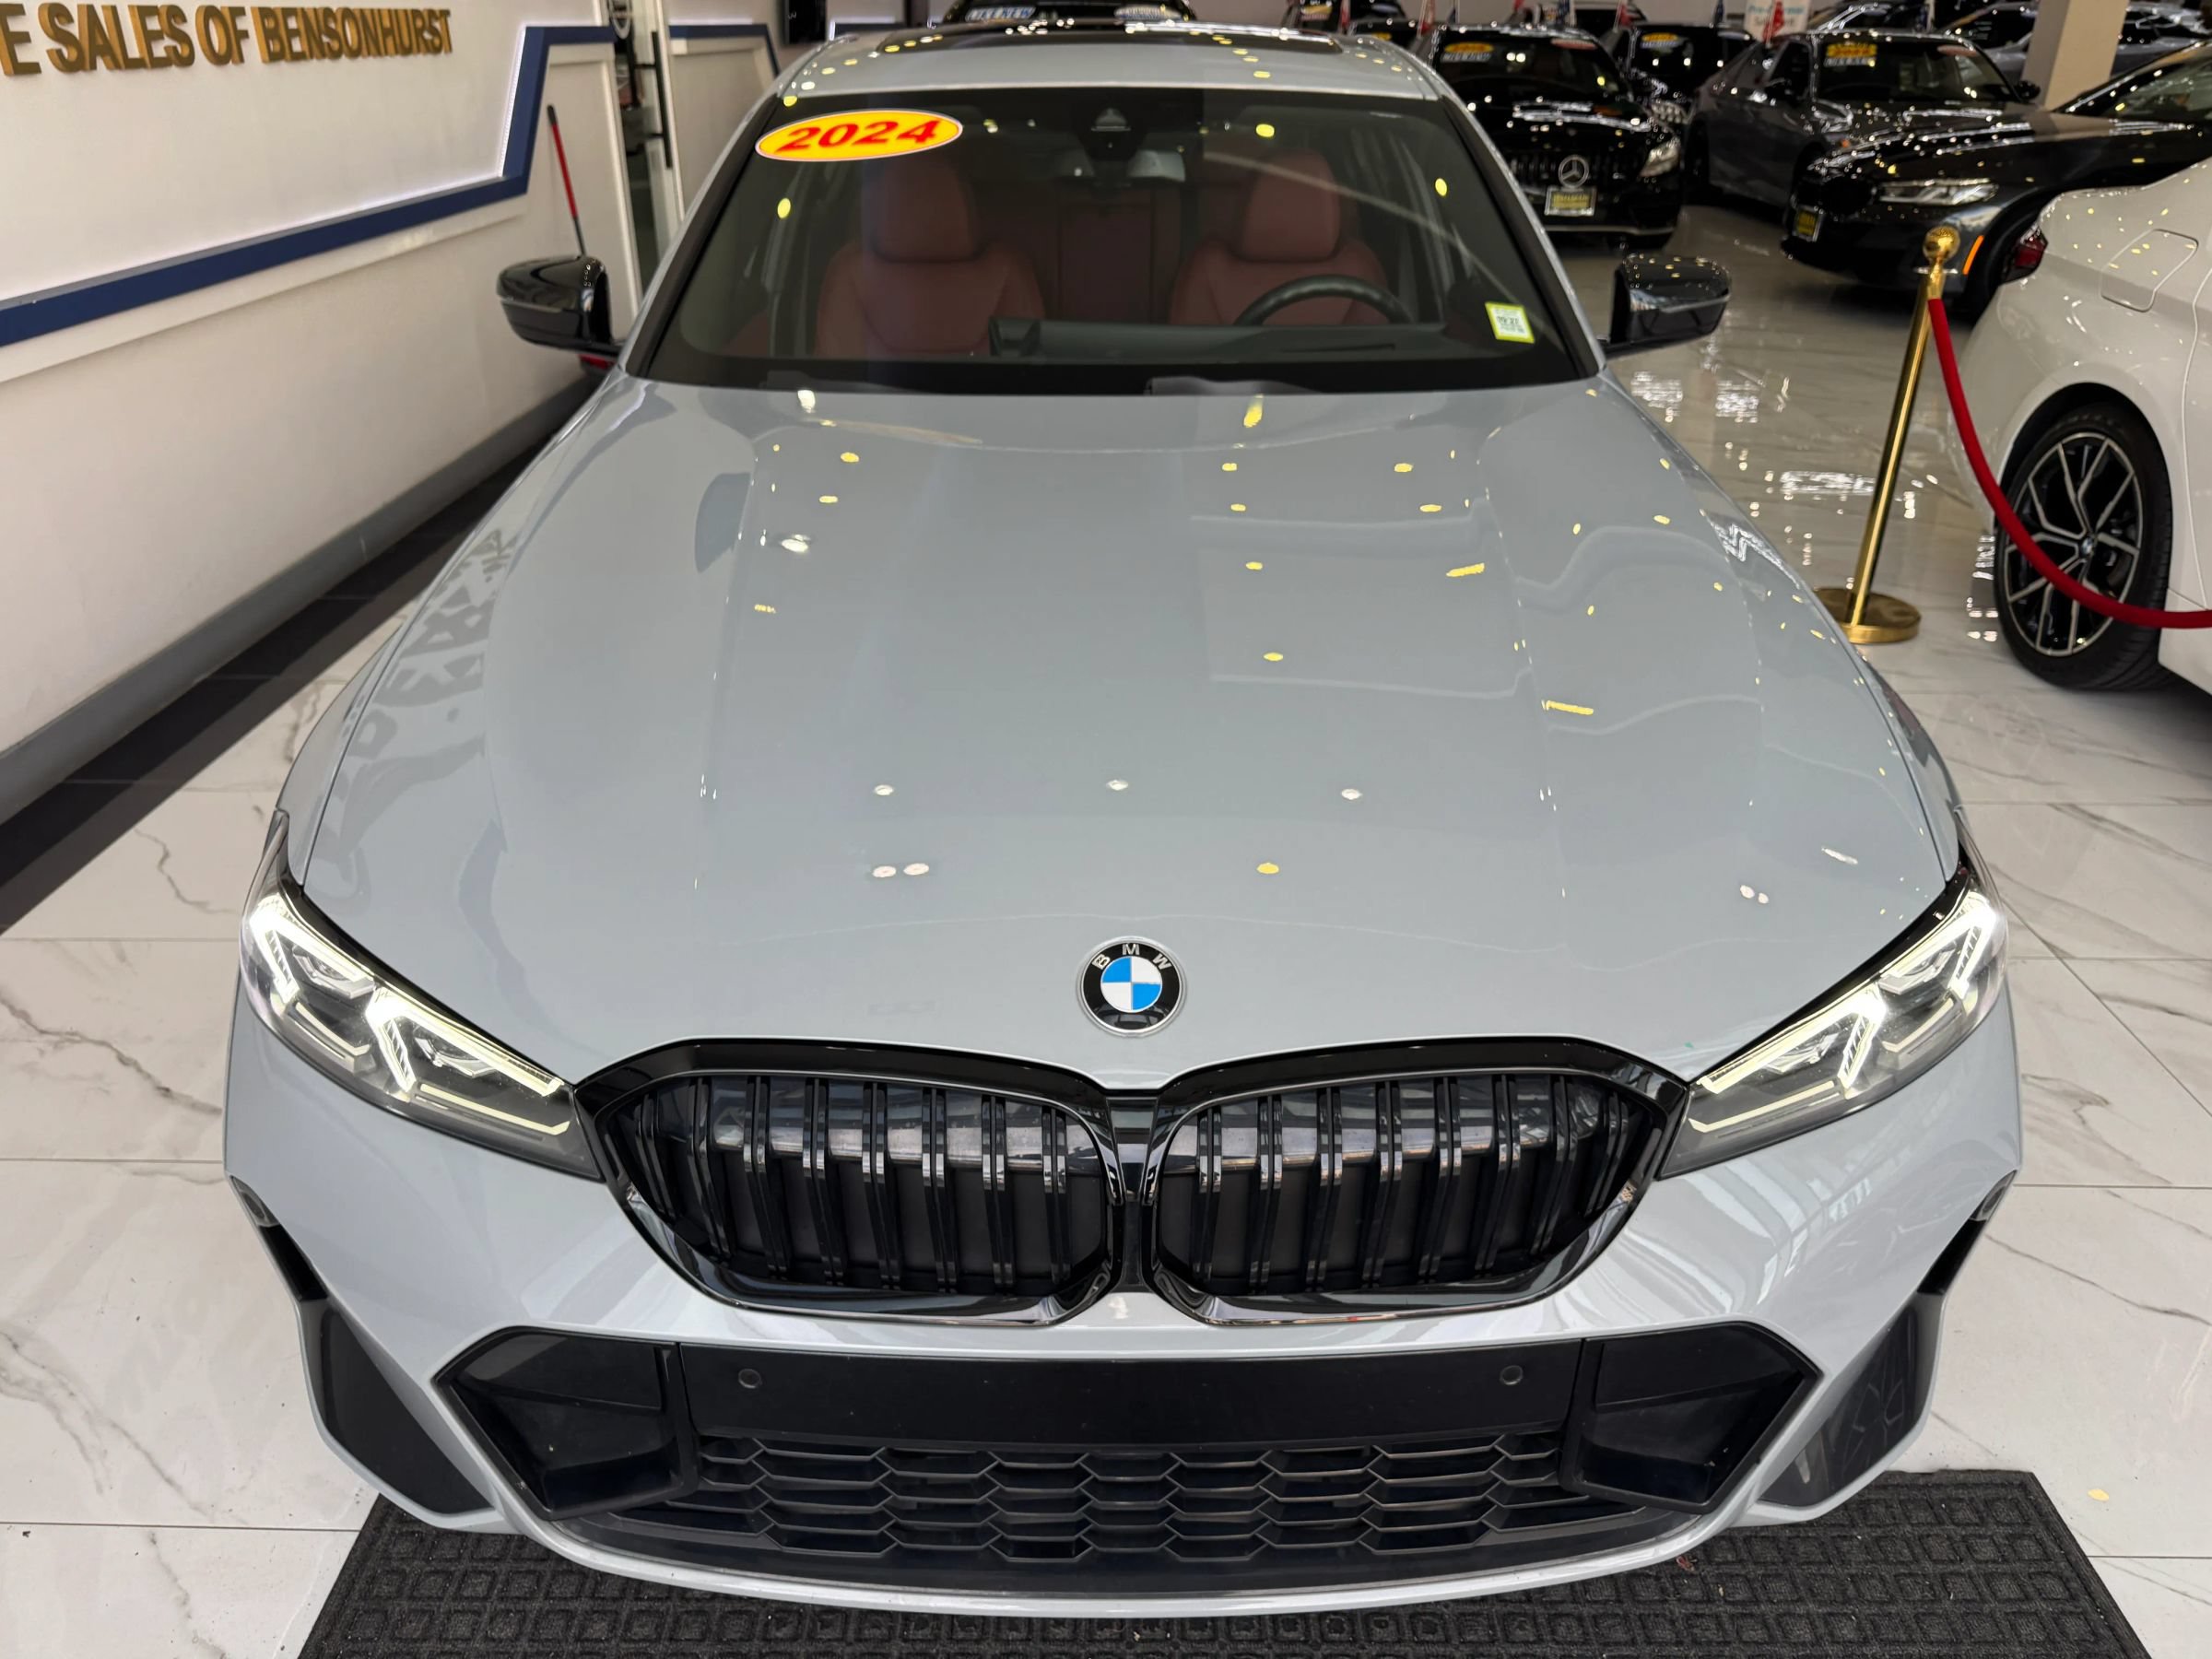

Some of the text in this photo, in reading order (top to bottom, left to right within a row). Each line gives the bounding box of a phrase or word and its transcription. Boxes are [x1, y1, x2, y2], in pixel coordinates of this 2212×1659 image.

[38, 3, 195, 73] SALES
[195, 6, 249, 65] OF
[251, 6, 453, 65] BENSONHURST
[774, 120, 942, 154] 2024
[1091, 943, 1172, 971] BMW
